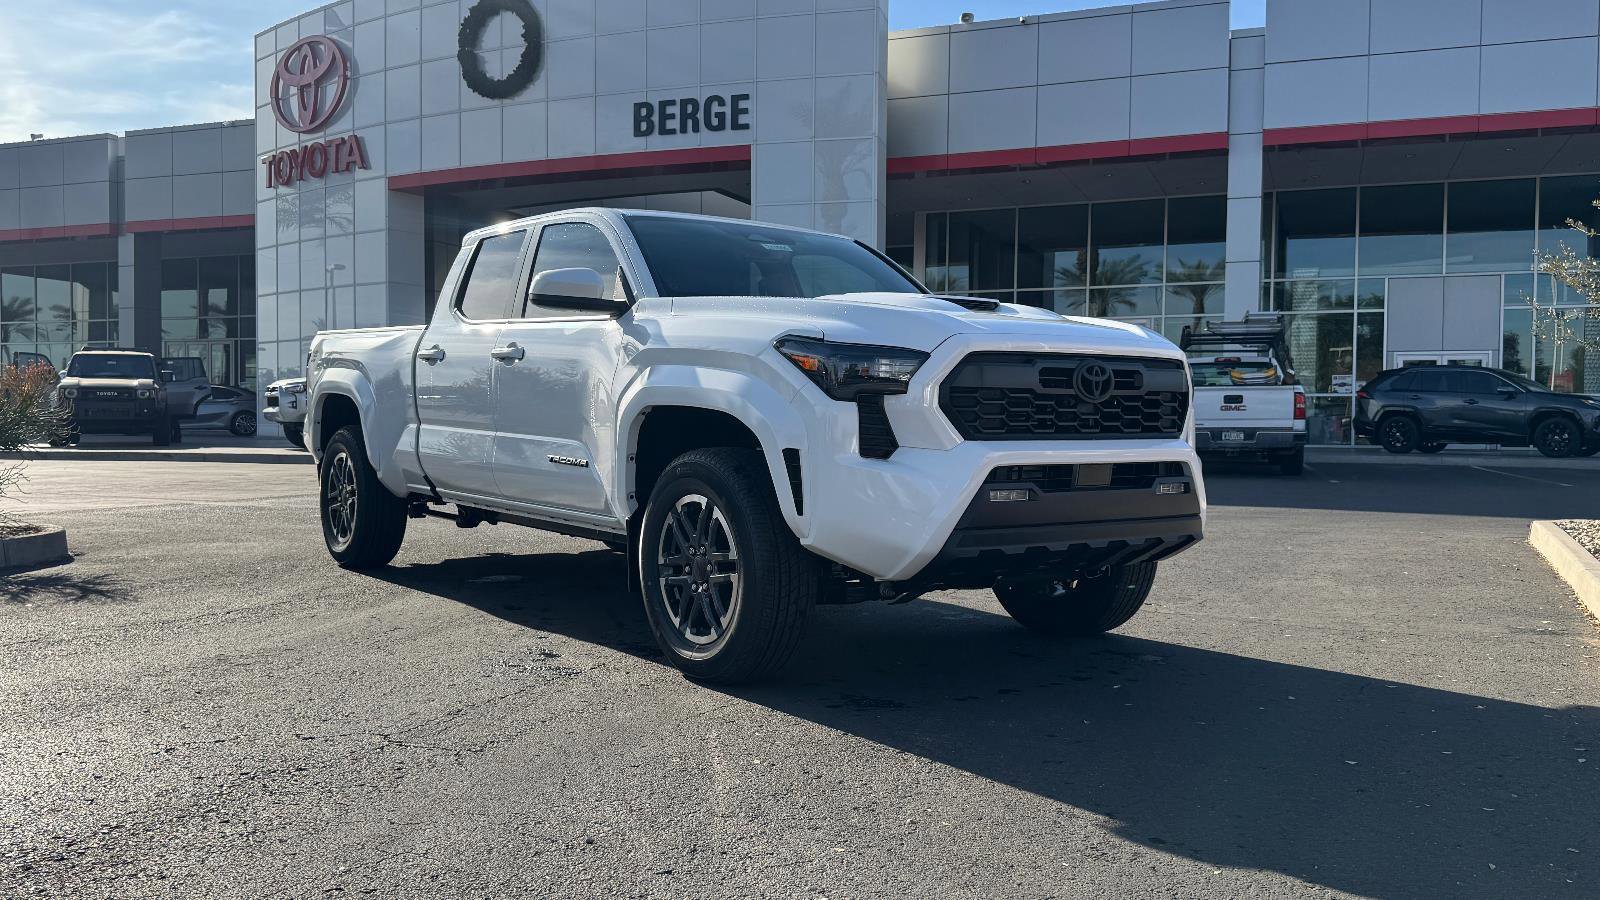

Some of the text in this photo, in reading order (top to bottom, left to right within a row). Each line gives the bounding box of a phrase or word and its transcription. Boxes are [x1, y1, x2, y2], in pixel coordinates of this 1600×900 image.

[633, 93, 750, 138] BERGE
[261, 134, 368, 189] TOYOTA
[546, 454, 589, 468] TACOMA
